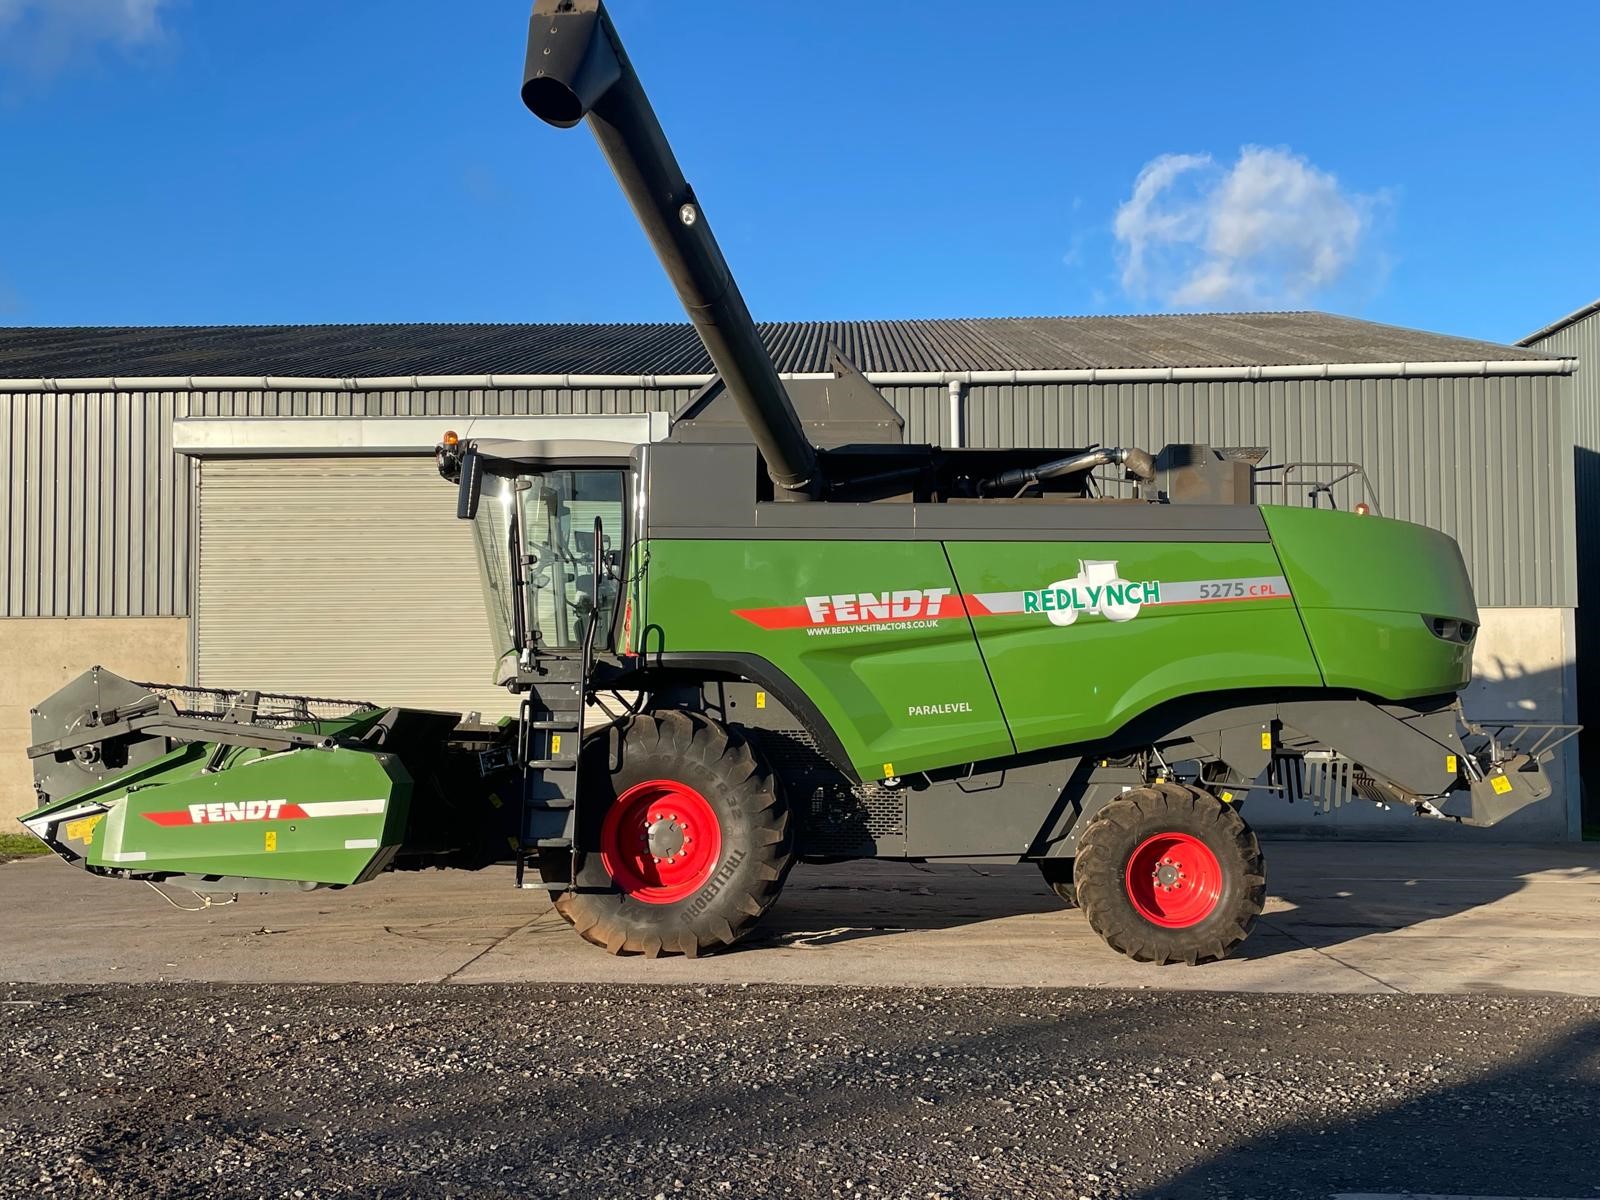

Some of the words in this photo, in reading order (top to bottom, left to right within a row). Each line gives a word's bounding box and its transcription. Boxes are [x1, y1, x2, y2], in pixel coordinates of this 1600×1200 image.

[1023, 580, 1161, 613] REDLYNCH
[1199, 582, 1245, 598] 5275
[805, 587, 951, 623] FENDT
[806, 620, 939, 636] WWW.REDLYNCHTRACTORS.CO.UK
[908, 702, 973, 716] PARALEVEL
[188, 799, 287, 824] FENDT
[680, 848, 747, 925] TRELLEBORG
